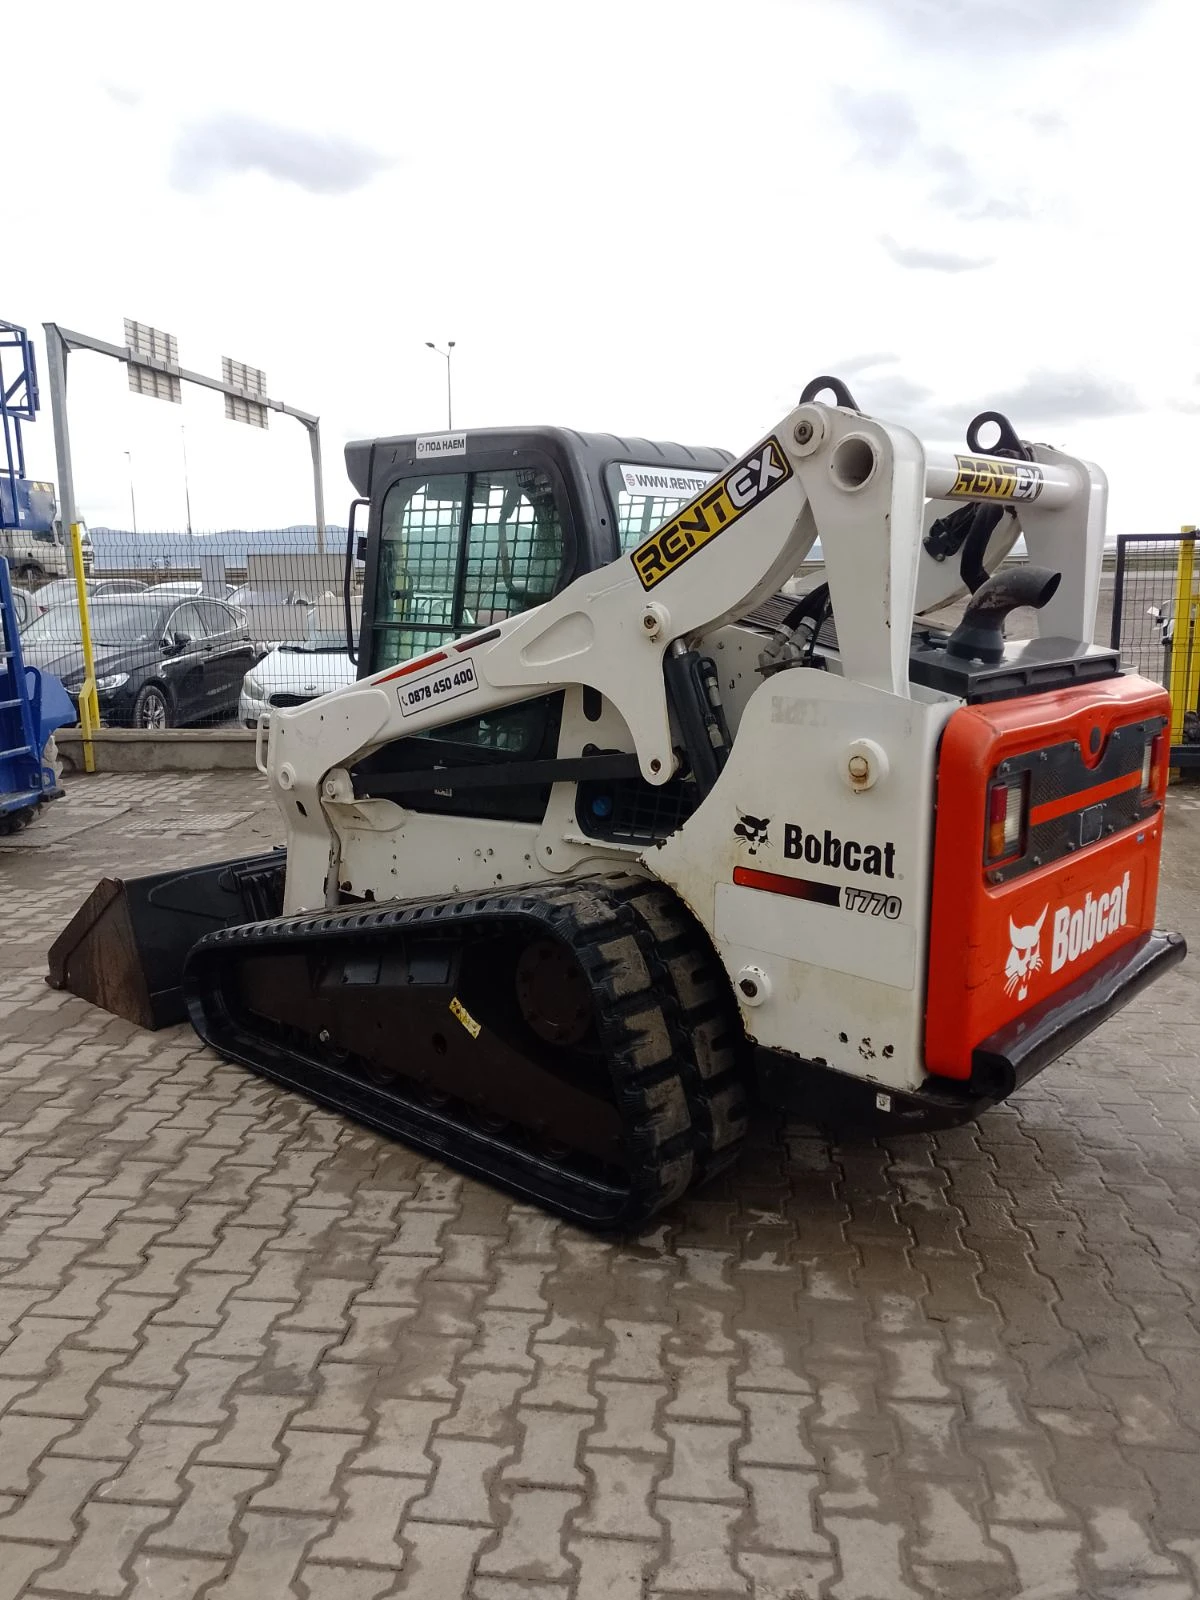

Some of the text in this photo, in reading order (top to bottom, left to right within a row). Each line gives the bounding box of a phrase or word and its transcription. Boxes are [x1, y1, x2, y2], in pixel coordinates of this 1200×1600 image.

[425, 439, 465, 451] ПОД НАЕМ
[955, 460, 1040, 499] RENTEX
[636, 445, 785, 583] RENTEX
[407, 668, 474, 705] 0878 450 400
[783, 822, 896, 879] Bobcat
[844, 886, 903, 920] T770
[1050, 870, 1131, 974] Bobcat
